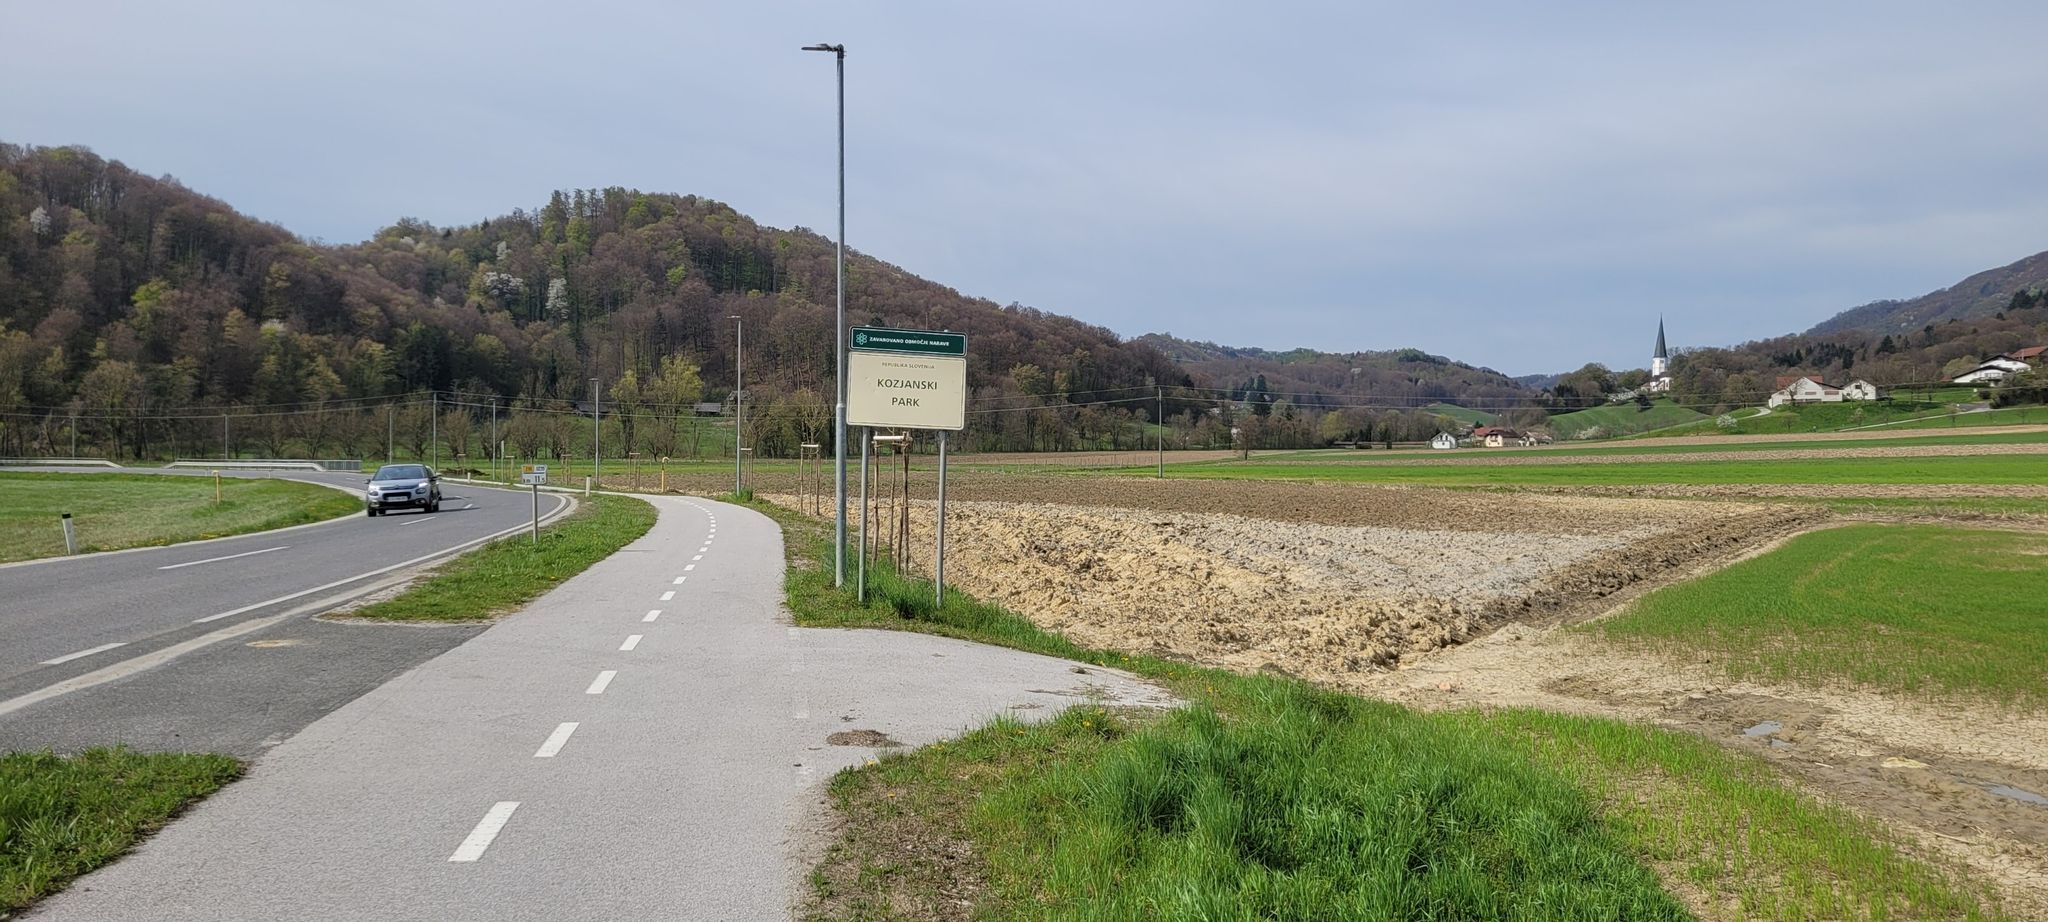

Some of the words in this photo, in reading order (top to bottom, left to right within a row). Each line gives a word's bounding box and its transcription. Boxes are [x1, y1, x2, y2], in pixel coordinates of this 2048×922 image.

[869, 336, 904, 344] ZAVAROVANO
[905, 338, 928, 346] OBMOČJE
[877, 378, 938, 390] KOZJANSKI
[891, 396, 920, 407] PARK
